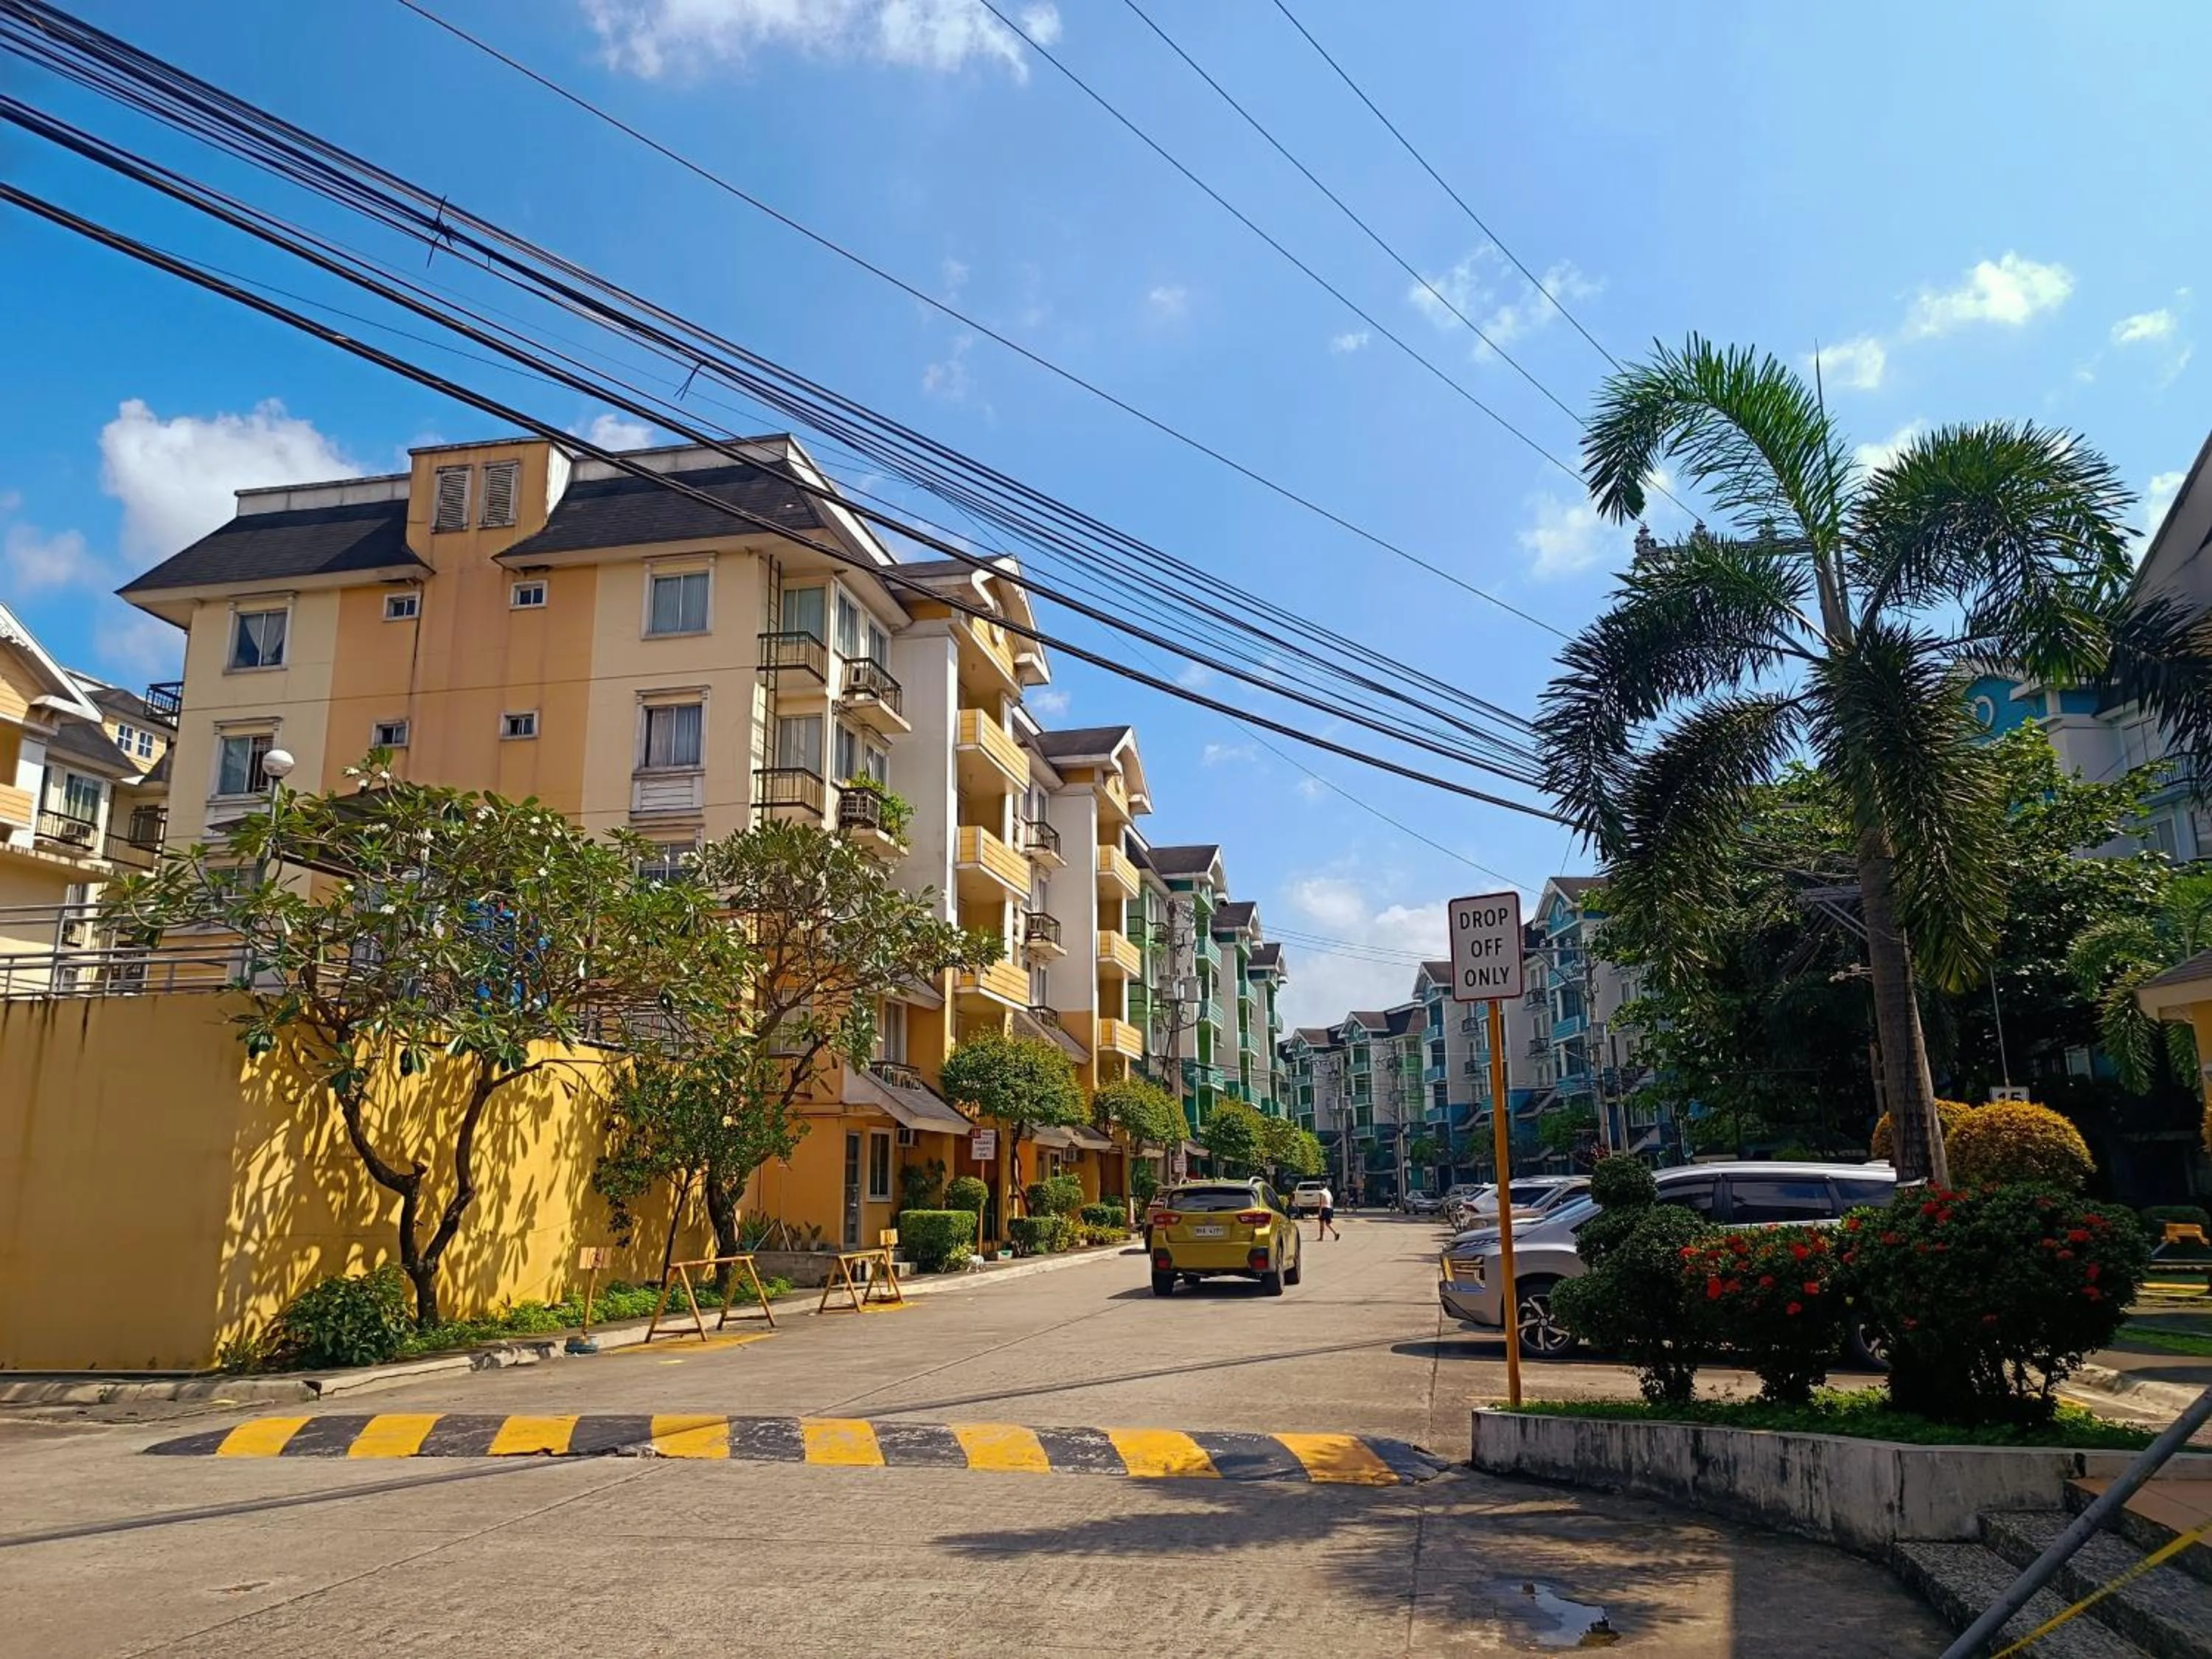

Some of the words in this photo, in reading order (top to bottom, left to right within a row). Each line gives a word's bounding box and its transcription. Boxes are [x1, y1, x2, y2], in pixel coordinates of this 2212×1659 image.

[1459, 908, 1508, 930] DROP
[1471, 938, 1502, 957] OFF
[1464, 967, 1509, 987] ONLY
